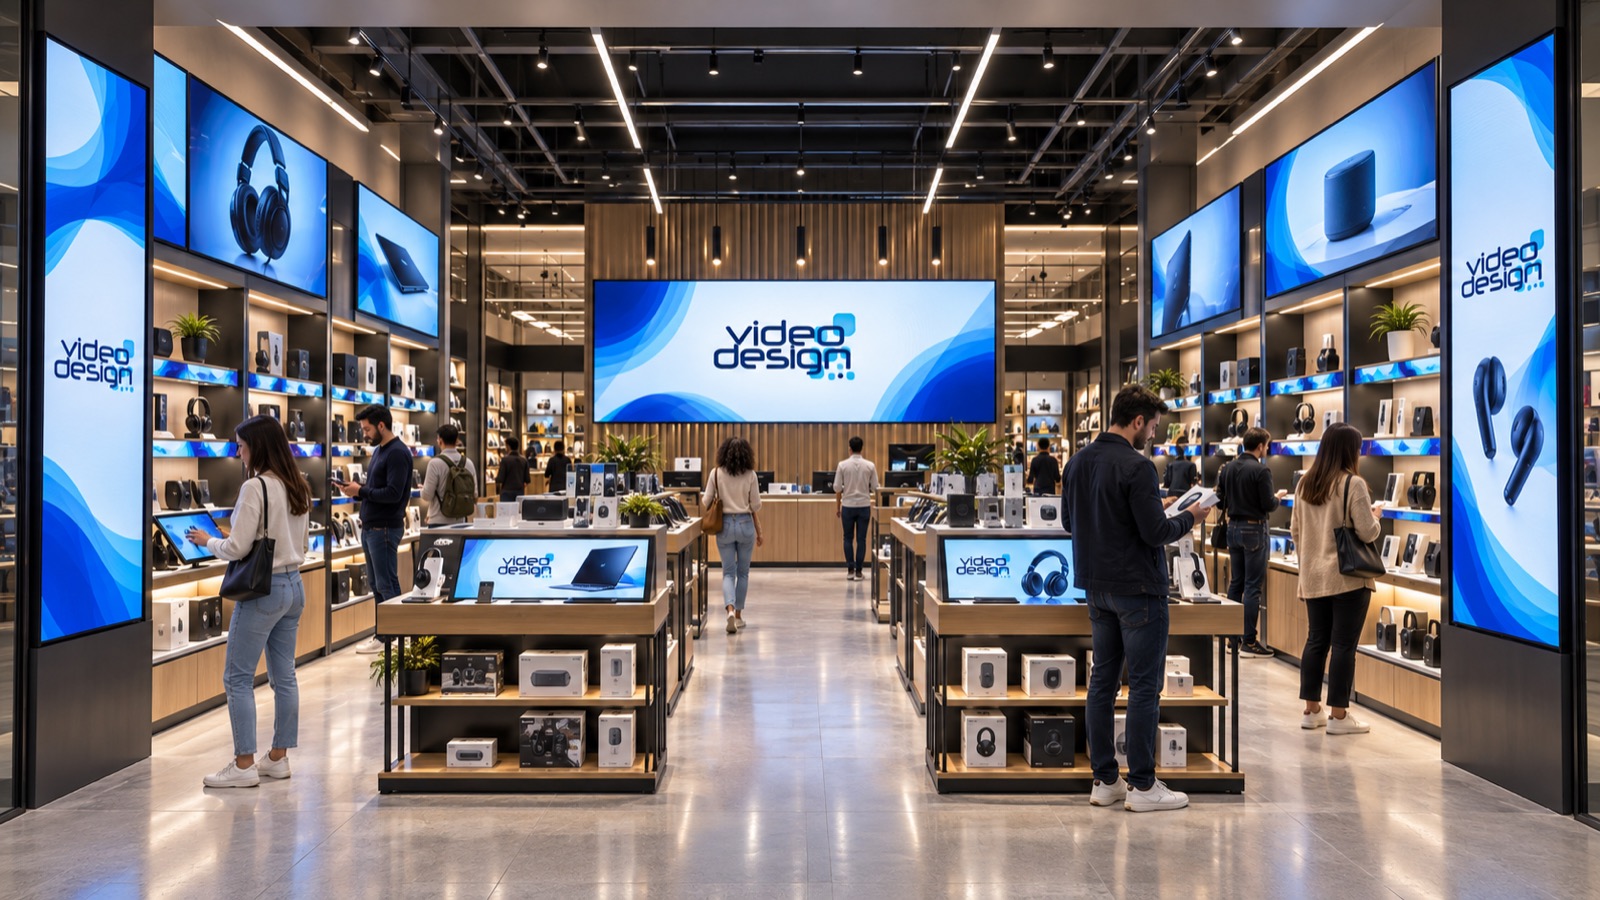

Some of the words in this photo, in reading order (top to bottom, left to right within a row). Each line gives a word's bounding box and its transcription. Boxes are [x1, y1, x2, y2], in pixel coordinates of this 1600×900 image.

[1466, 241, 1538, 276] video
[1461, 262, 1542, 298] design
[725, 319, 845, 347] video
[61, 337, 129, 365] video
[713, 344, 851, 375] design
[54, 356, 132, 388] design
[497, 565, 552, 578] design
[502, 555, 550, 566] video
[956, 565, 1010, 577] design
[959, 555, 1007, 566] video
